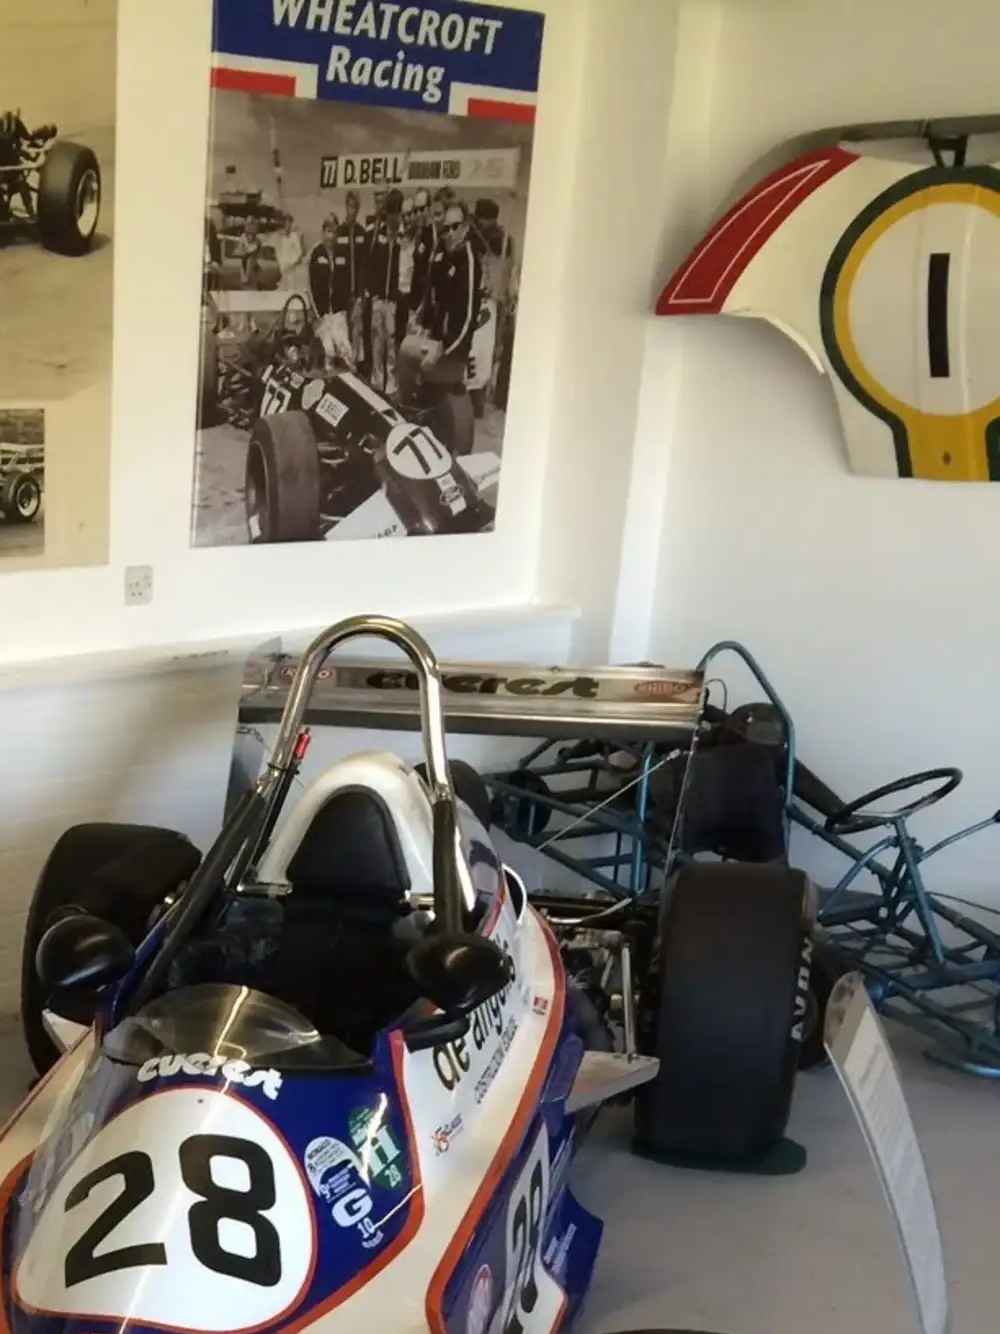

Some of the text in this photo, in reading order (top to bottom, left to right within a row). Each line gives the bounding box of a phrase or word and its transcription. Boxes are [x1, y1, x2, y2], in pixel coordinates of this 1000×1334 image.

[270, 0, 503, 55] WHEATCROFT
[326, 44, 445, 103] Racing
[137, 1050, 283, 1100] everest
[64, 1133, 282, 1288] 28
